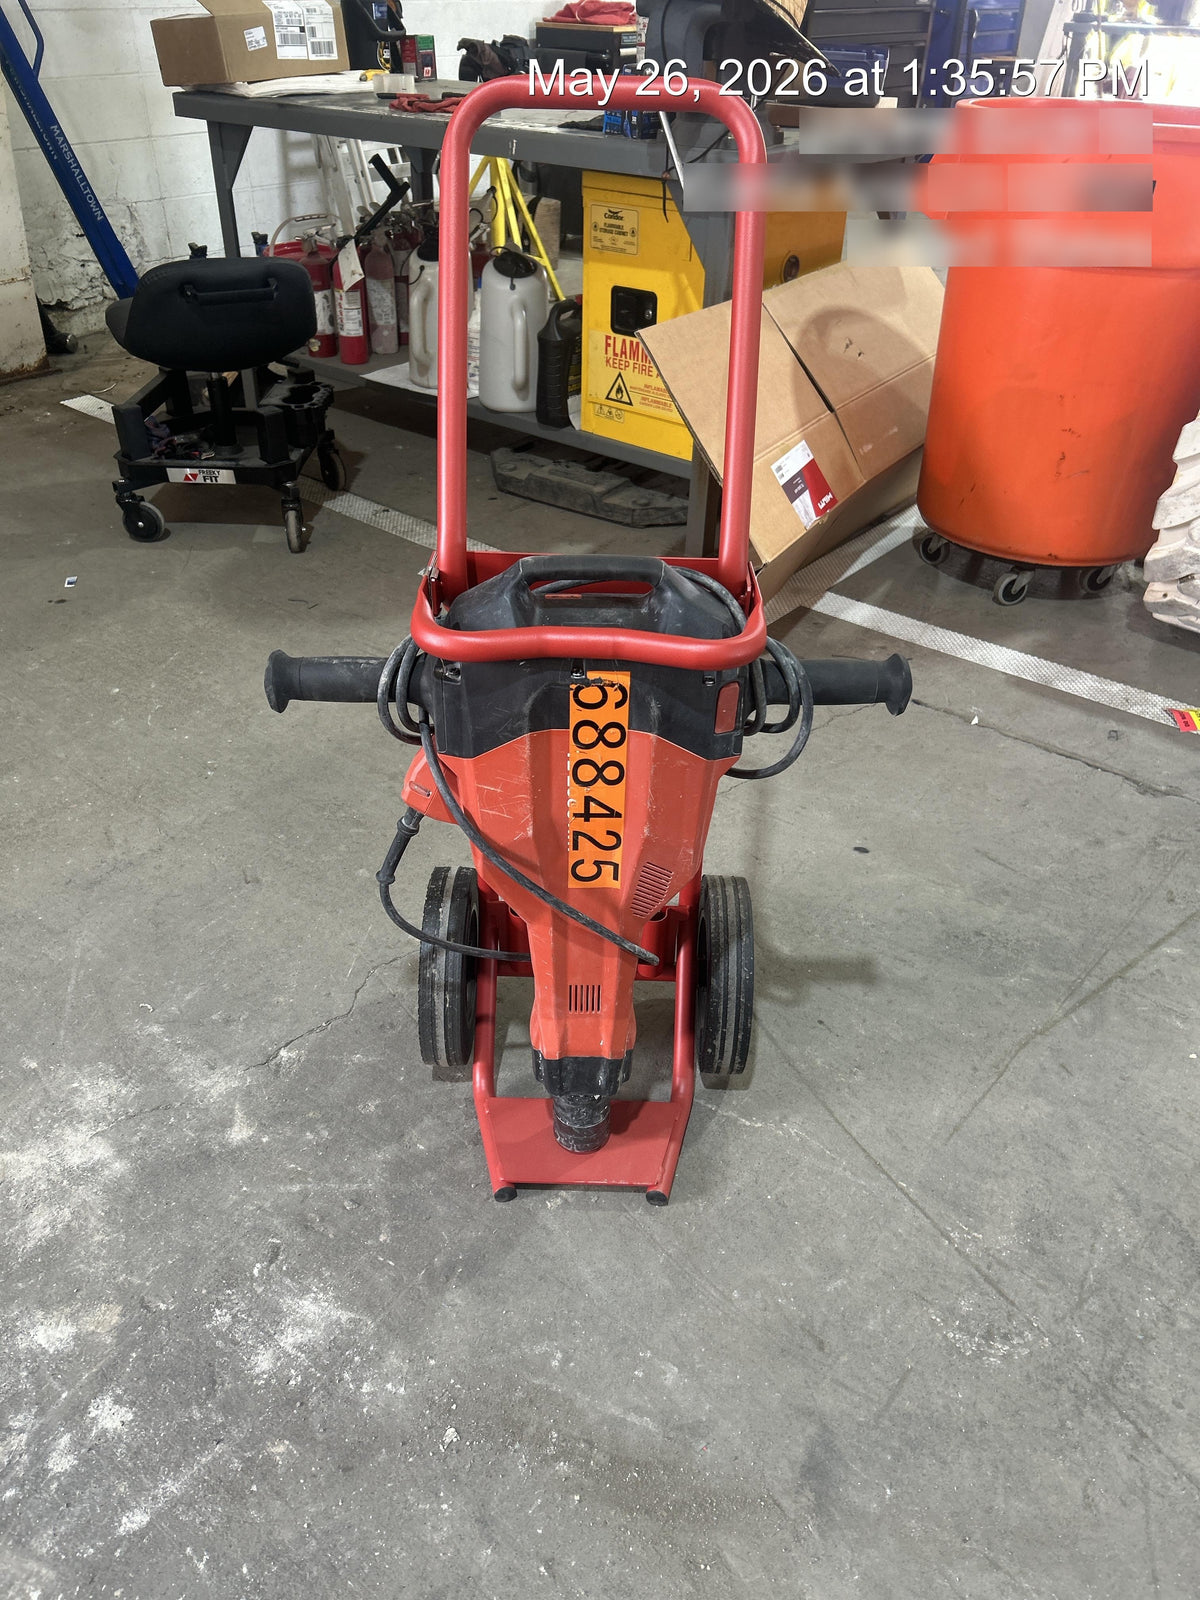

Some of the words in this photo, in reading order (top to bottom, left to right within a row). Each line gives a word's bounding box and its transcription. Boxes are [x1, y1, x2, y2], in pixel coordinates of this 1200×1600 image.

[50, 124, 104, 221] MARSHALLTOWN
[605, 356, 630, 371] KEEP
[632, 362, 654, 377] FIRE
[570, 683, 629, 883] 688425
